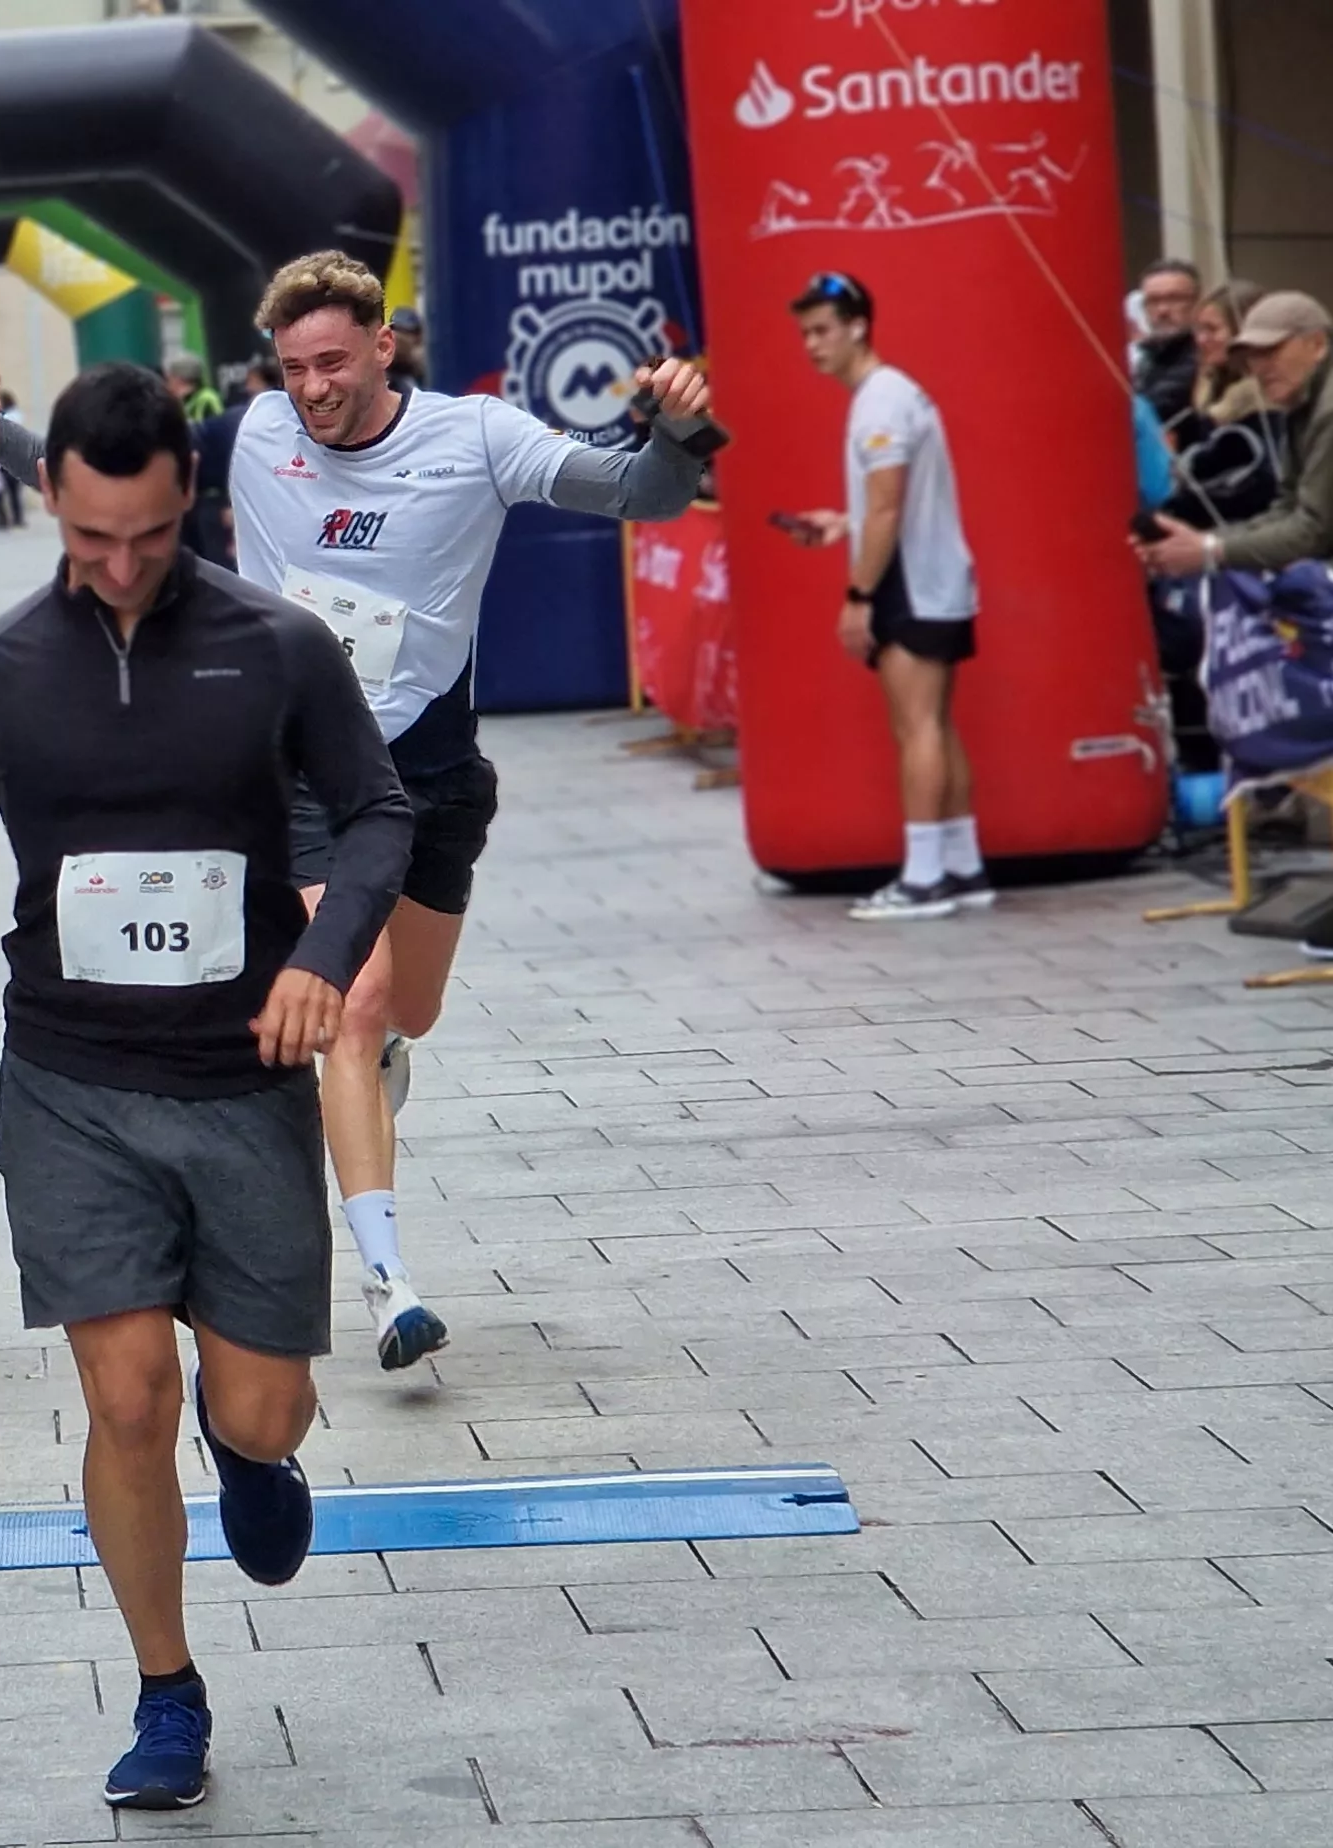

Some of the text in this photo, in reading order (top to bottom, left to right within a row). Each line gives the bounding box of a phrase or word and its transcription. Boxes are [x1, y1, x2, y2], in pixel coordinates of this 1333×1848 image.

[802, 51, 1082, 119] Santander
[483, 205, 688, 256] fundación
[519, 253, 652, 301] mupol
[120, 922, 191, 952] 103
